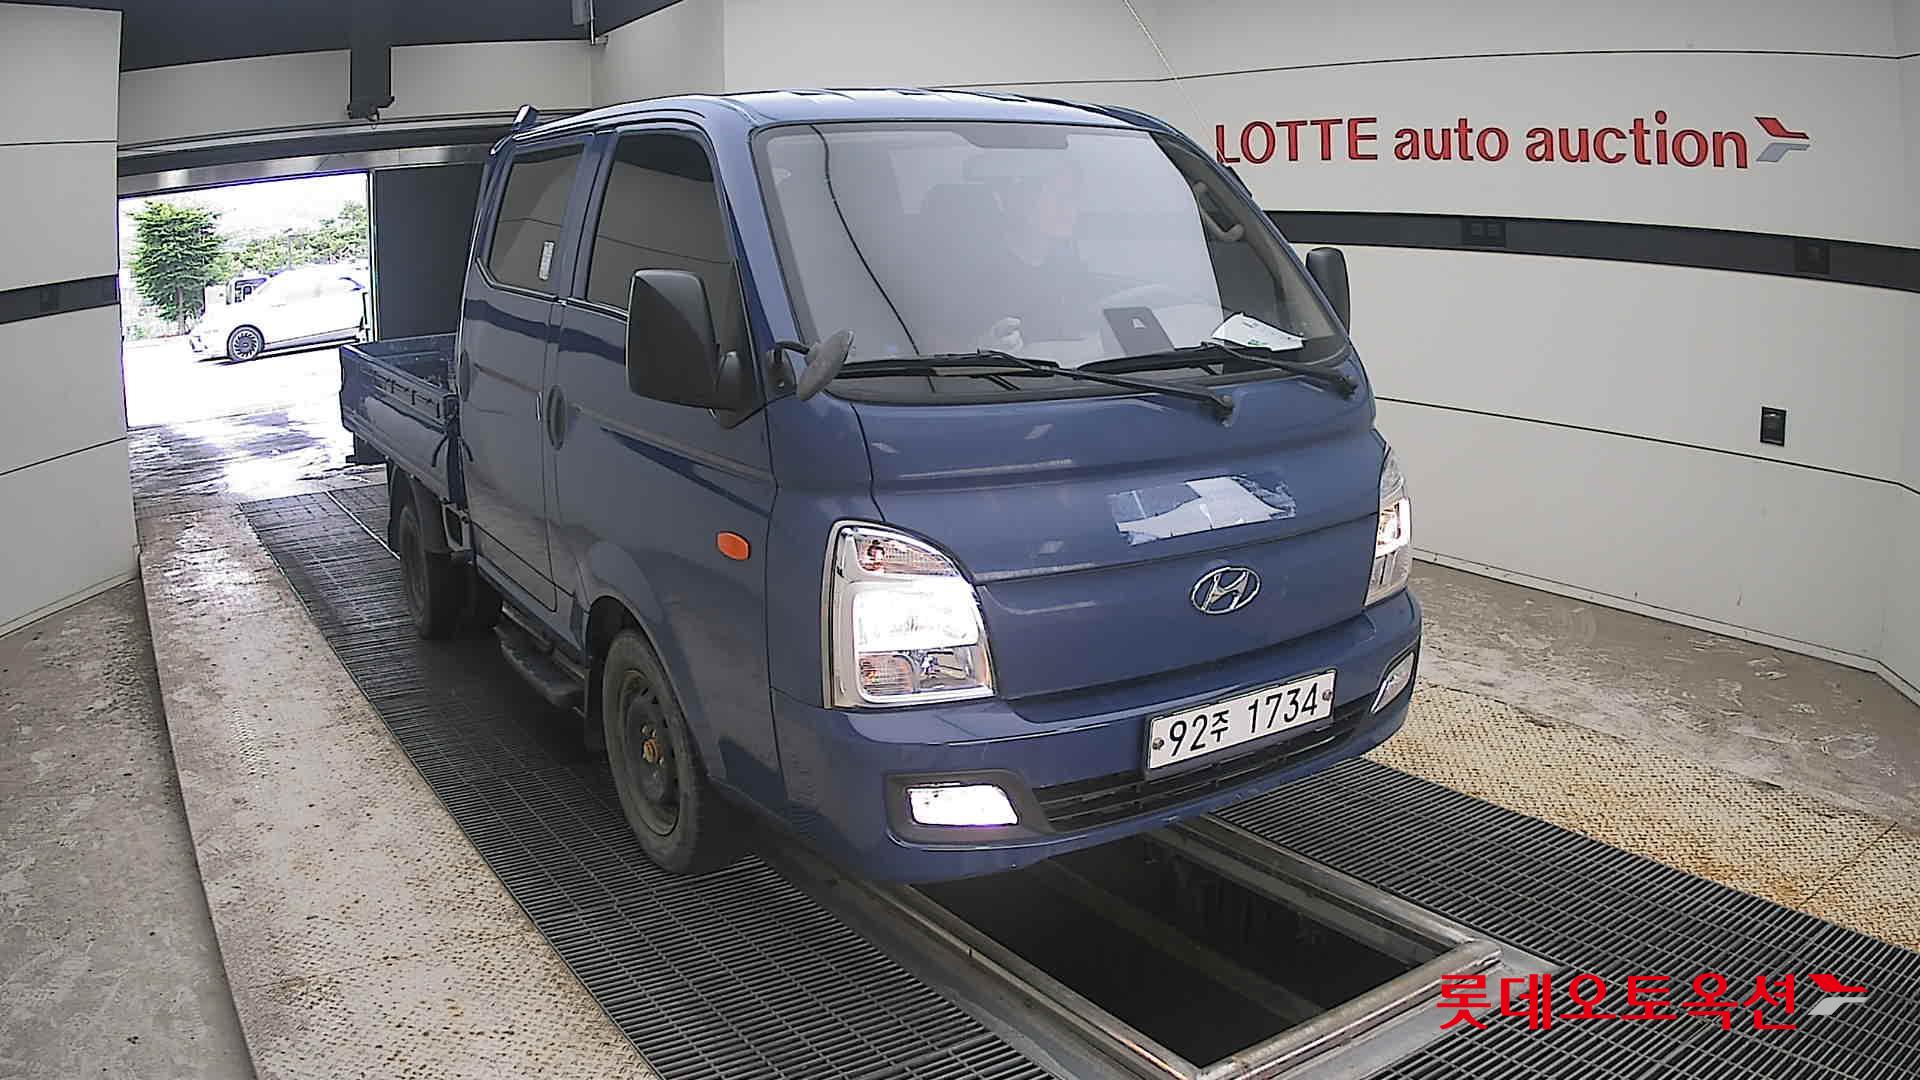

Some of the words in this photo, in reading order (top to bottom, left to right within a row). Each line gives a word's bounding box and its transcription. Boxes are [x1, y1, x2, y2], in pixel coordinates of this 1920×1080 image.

[1215, 117, 1378, 164] LOTTE
[1393, 117, 1509, 163] auto
[1525, 110, 1749, 169] auction
[1168, 709, 1230, 757] 92주
[1247, 682, 1319, 734] 1734
